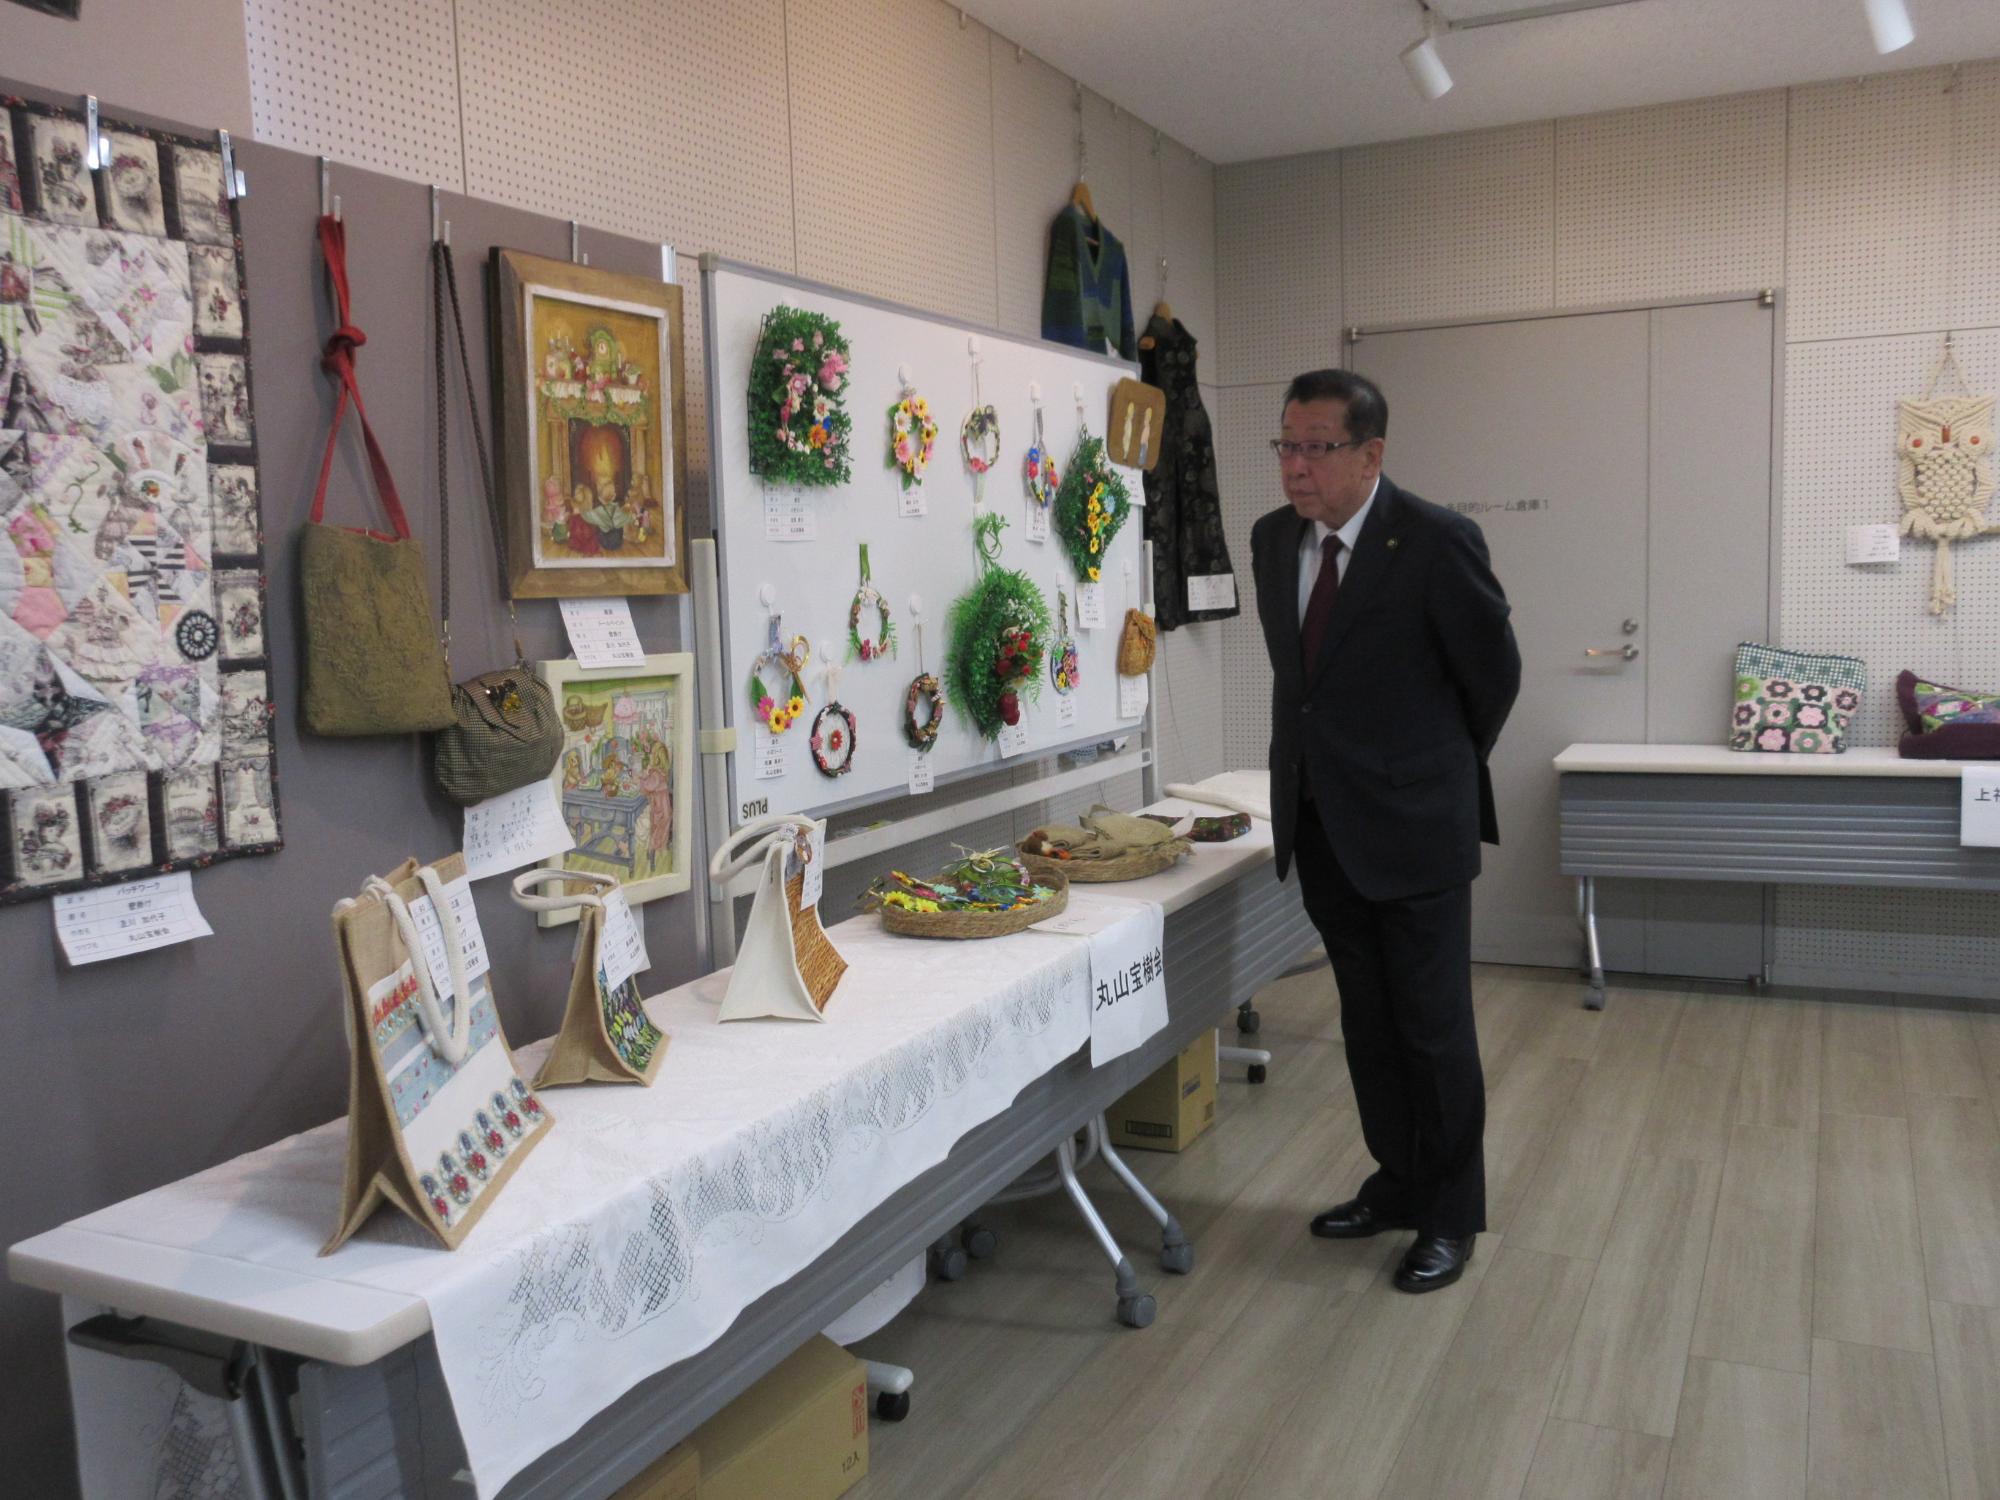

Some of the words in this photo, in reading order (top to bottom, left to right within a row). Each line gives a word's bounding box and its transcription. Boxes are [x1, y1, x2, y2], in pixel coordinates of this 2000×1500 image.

[742, 797, 768, 819] PLUS
[1095, 946, 1162, 1011] 丸山宝樹会
